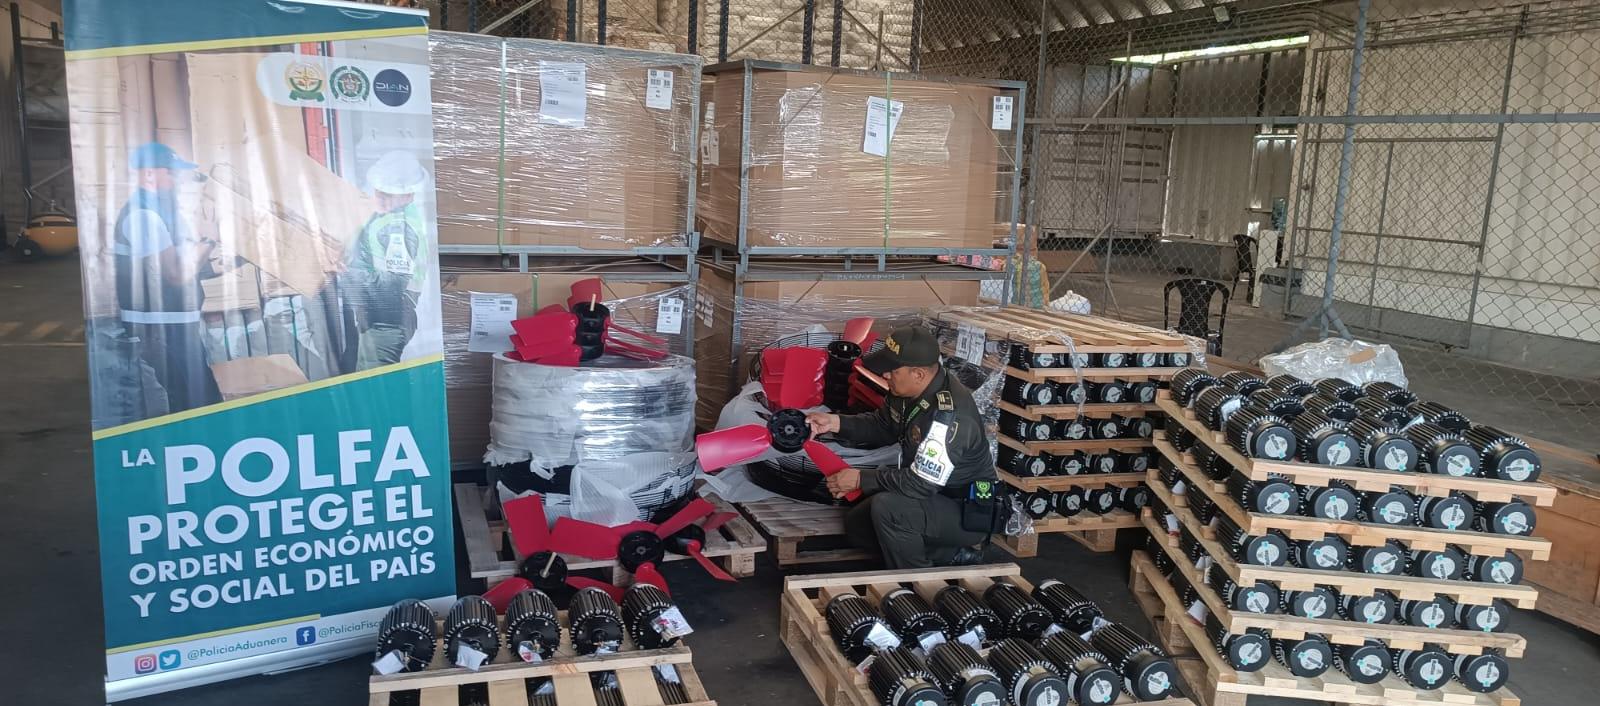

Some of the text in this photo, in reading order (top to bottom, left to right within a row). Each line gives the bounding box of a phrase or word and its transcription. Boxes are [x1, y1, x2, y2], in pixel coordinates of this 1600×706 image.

[121, 425, 432, 505] LA POLFA
[915, 454, 942, 473] POLICIA
[127, 484, 433, 555] PROTEGE EL
[129, 525, 435, 586] ORDEN ECONÓMICO
[130, 547, 436, 618] Y SOCIAL DEL PAÍS
[187, 636, 288, 661] @PoliciaAduanera
